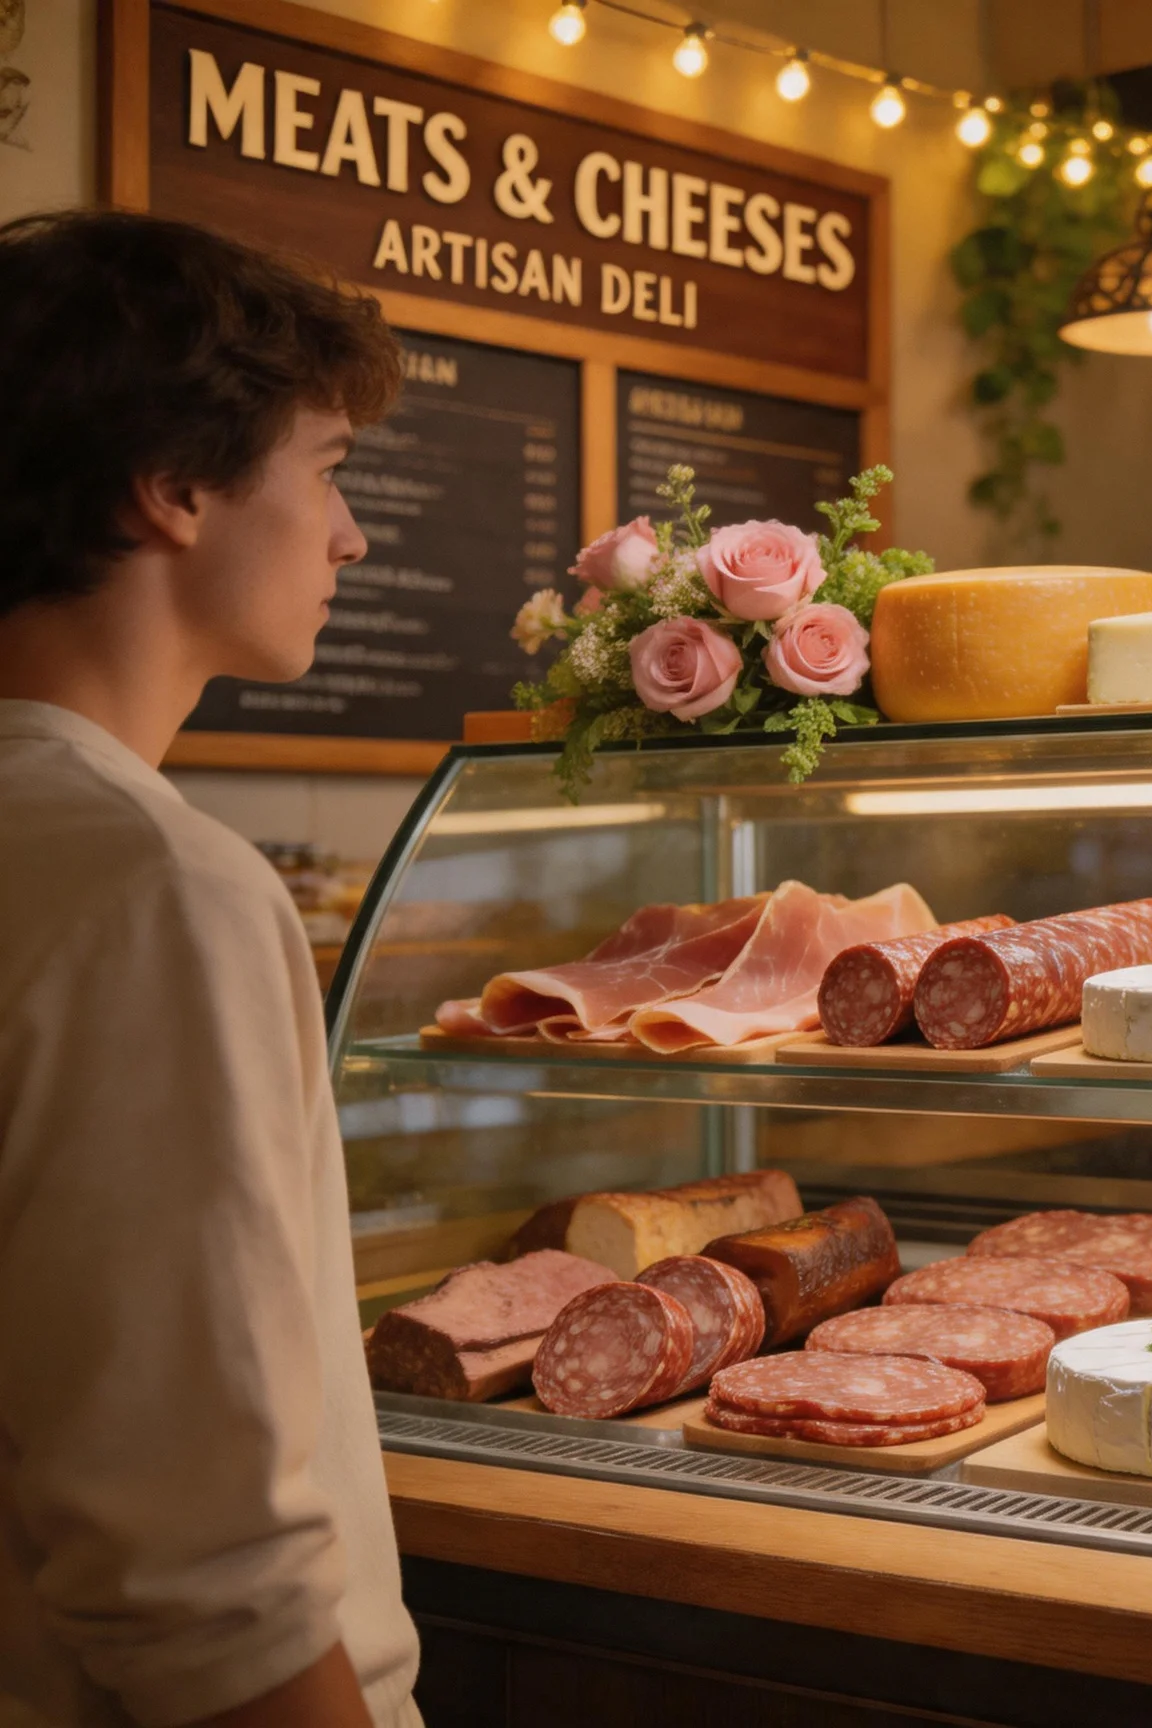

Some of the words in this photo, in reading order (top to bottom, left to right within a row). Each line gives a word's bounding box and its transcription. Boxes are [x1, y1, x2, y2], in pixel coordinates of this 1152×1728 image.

[188, 48, 470, 204] MEATS
[493, 133, 555, 224] &
[574, 151, 855, 291] CHEESES
[373, 219, 582, 306] ARTISAN
[601, 263, 697, 329] DELI
